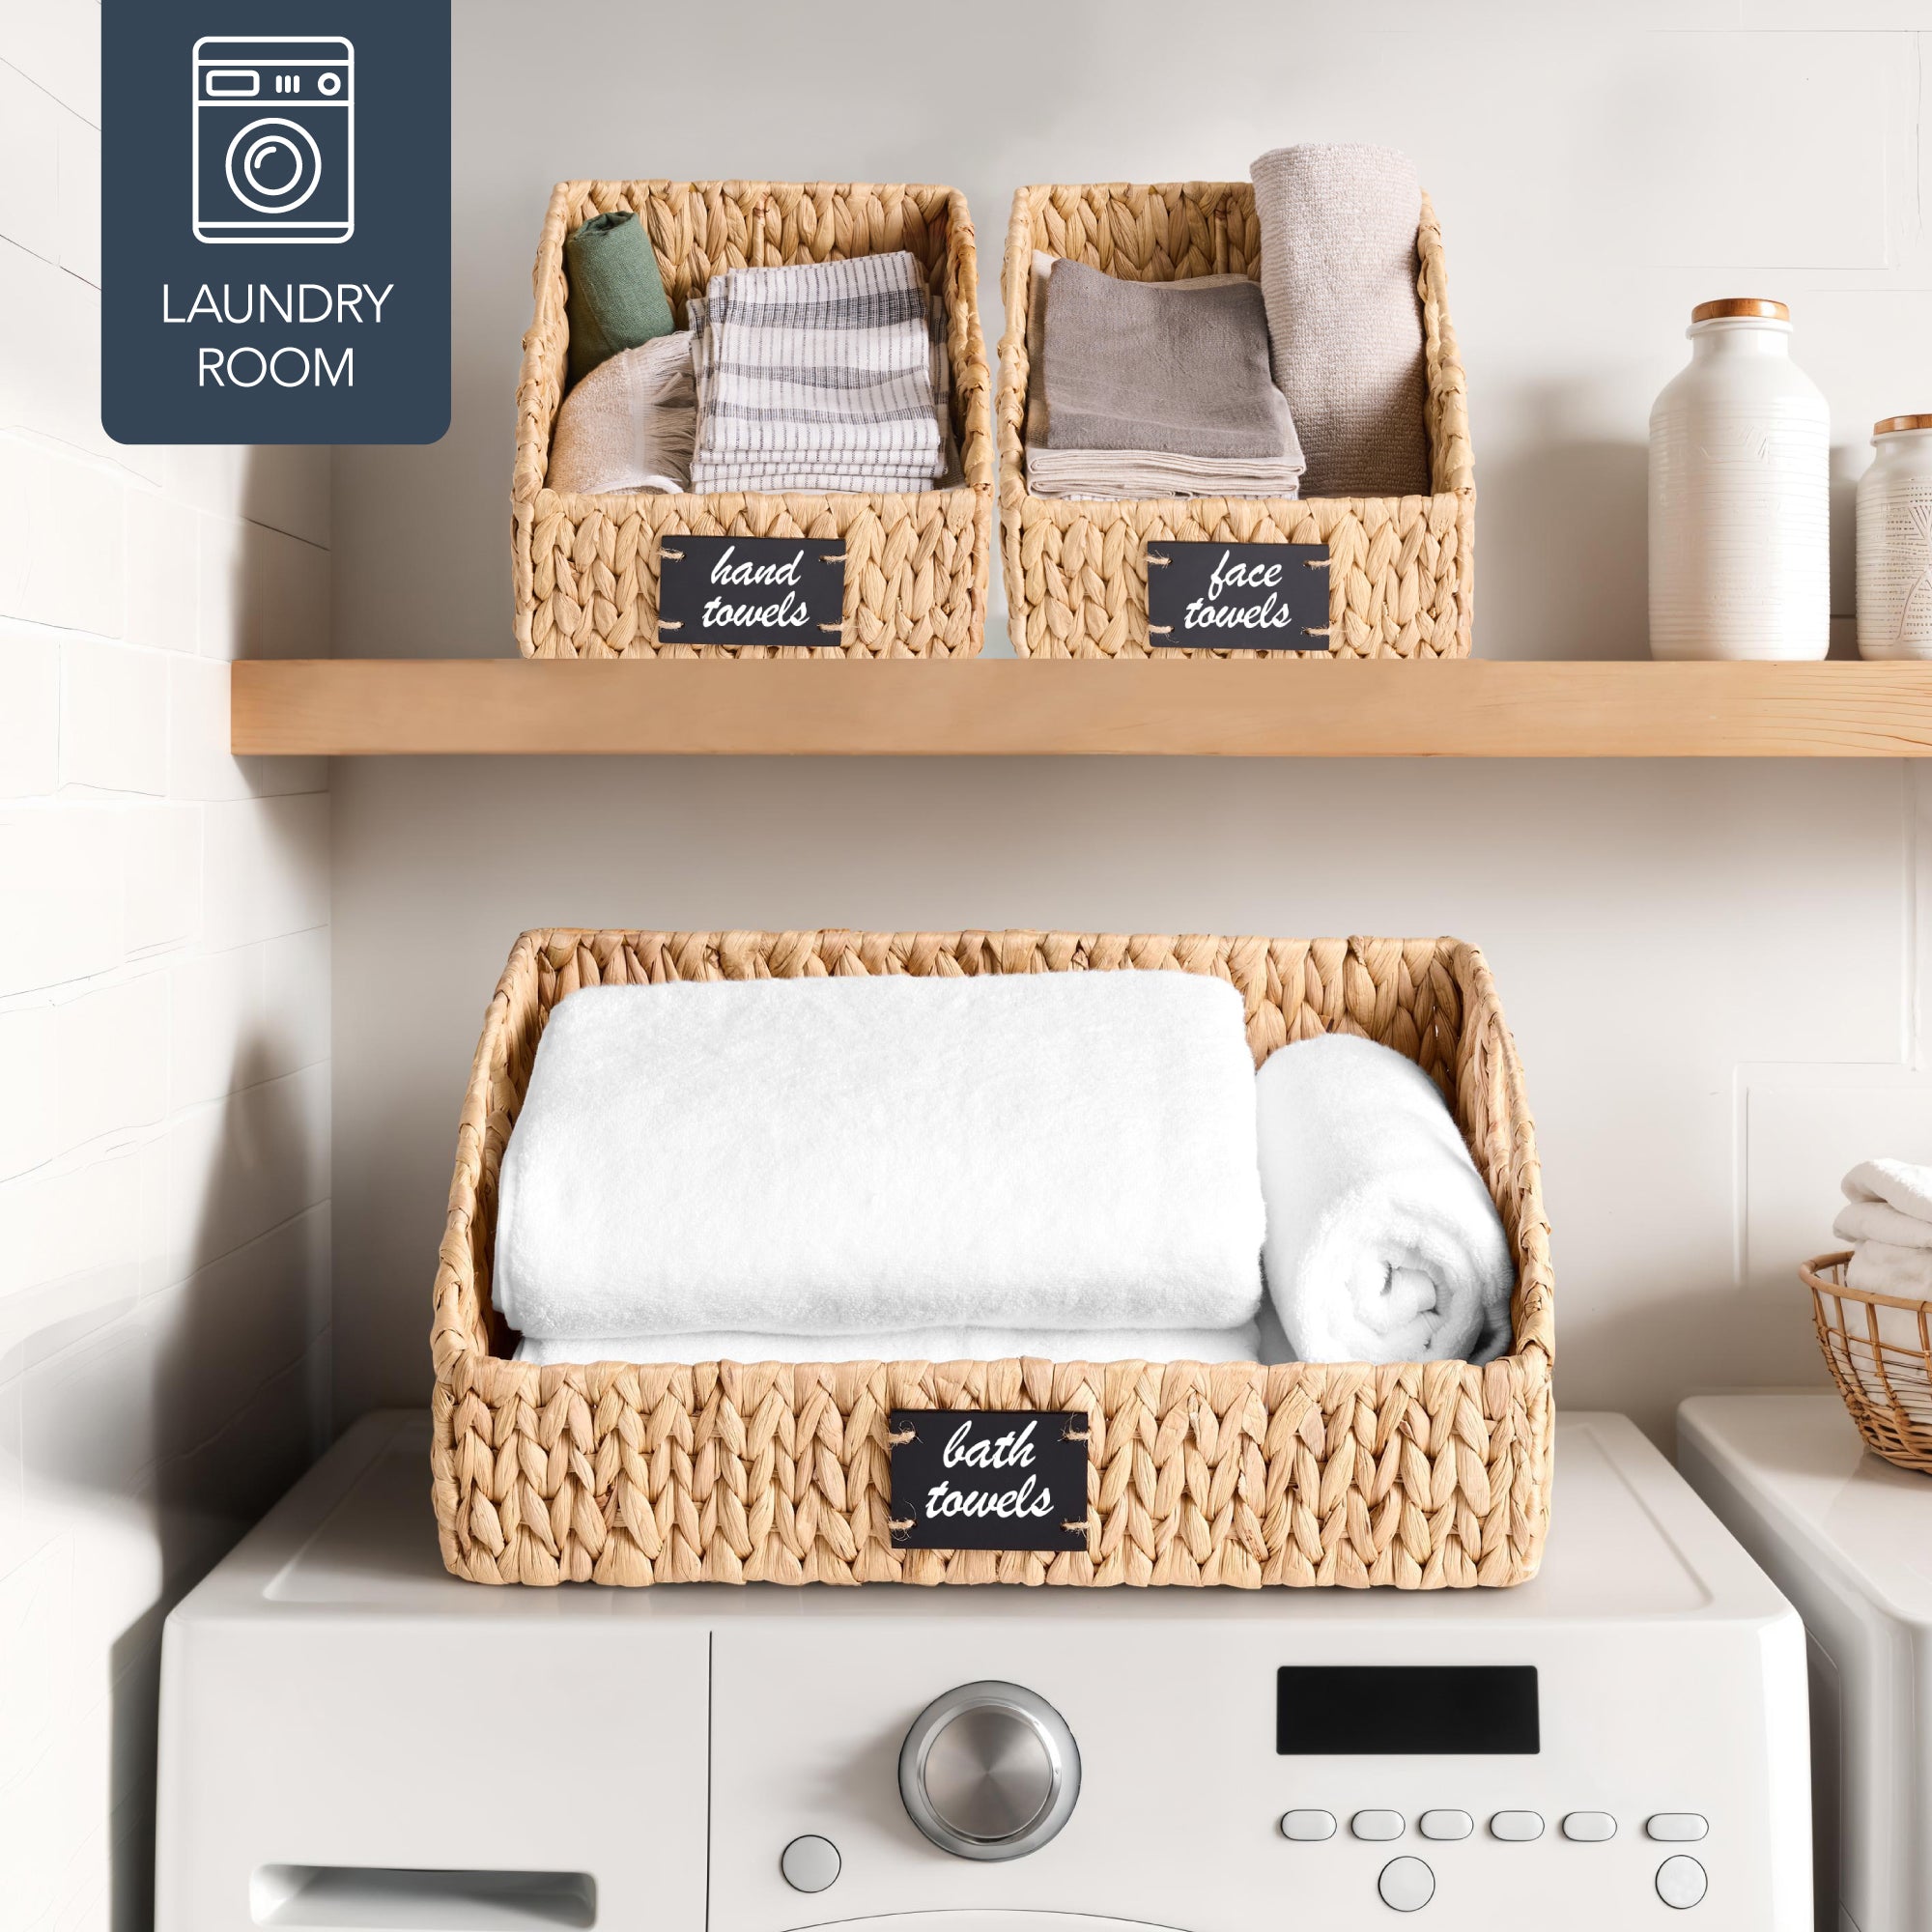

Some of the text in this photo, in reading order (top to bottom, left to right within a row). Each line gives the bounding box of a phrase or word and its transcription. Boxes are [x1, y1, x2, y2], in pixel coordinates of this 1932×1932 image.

[710, 545, 805, 586] hand
[1208, 549, 1283, 602] face
[701, 590, 810, 628] towels
[1183, 591, 1293, 630] towels
[943, 1420, 1037, 1469] bath
[924, 1473, 1055, 1519] towels
